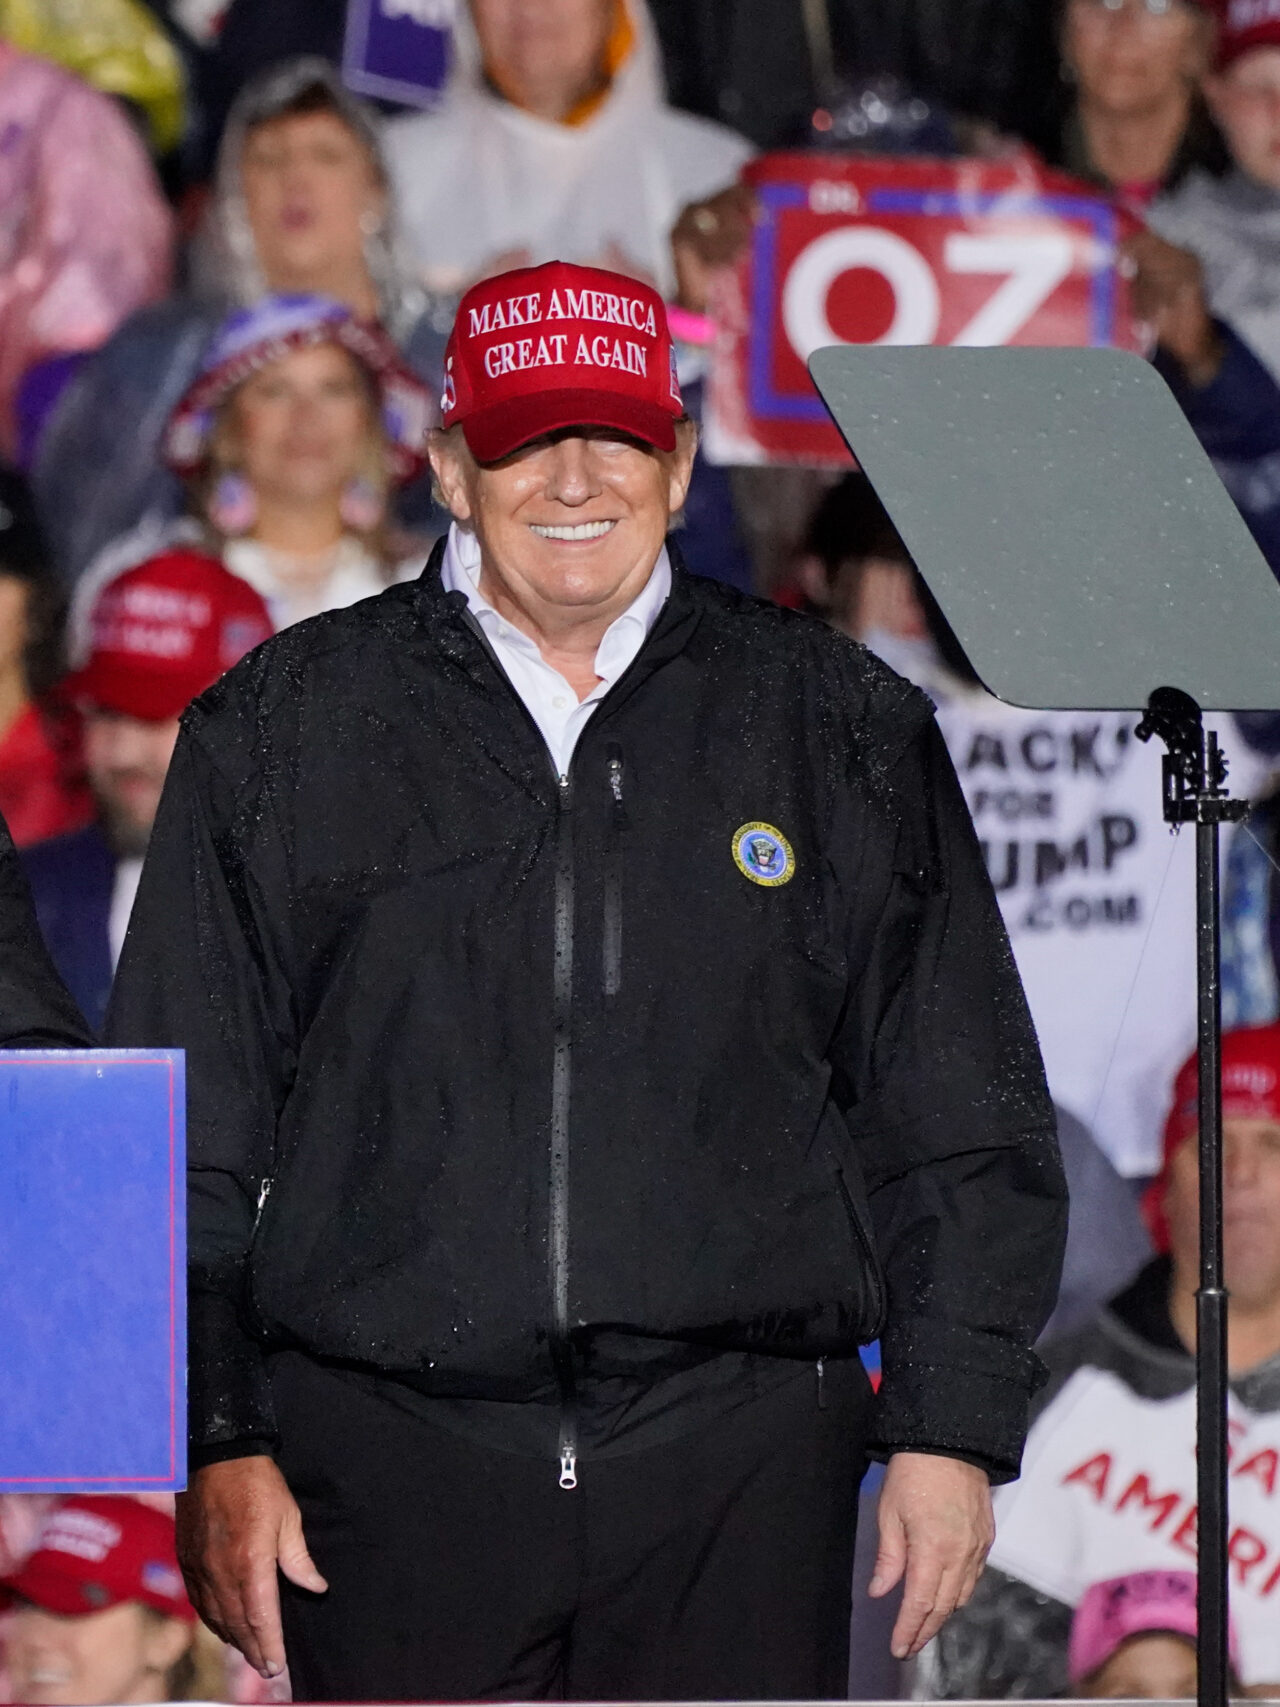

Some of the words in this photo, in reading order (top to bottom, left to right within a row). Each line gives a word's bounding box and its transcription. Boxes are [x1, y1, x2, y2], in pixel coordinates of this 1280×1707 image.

[468, 292, 542, 338] MAKE
[545, 288, 658, 338] AMERICA
[484, 334, 568, 379] GREAT
[573, 333, 647, 379] AGAIN
